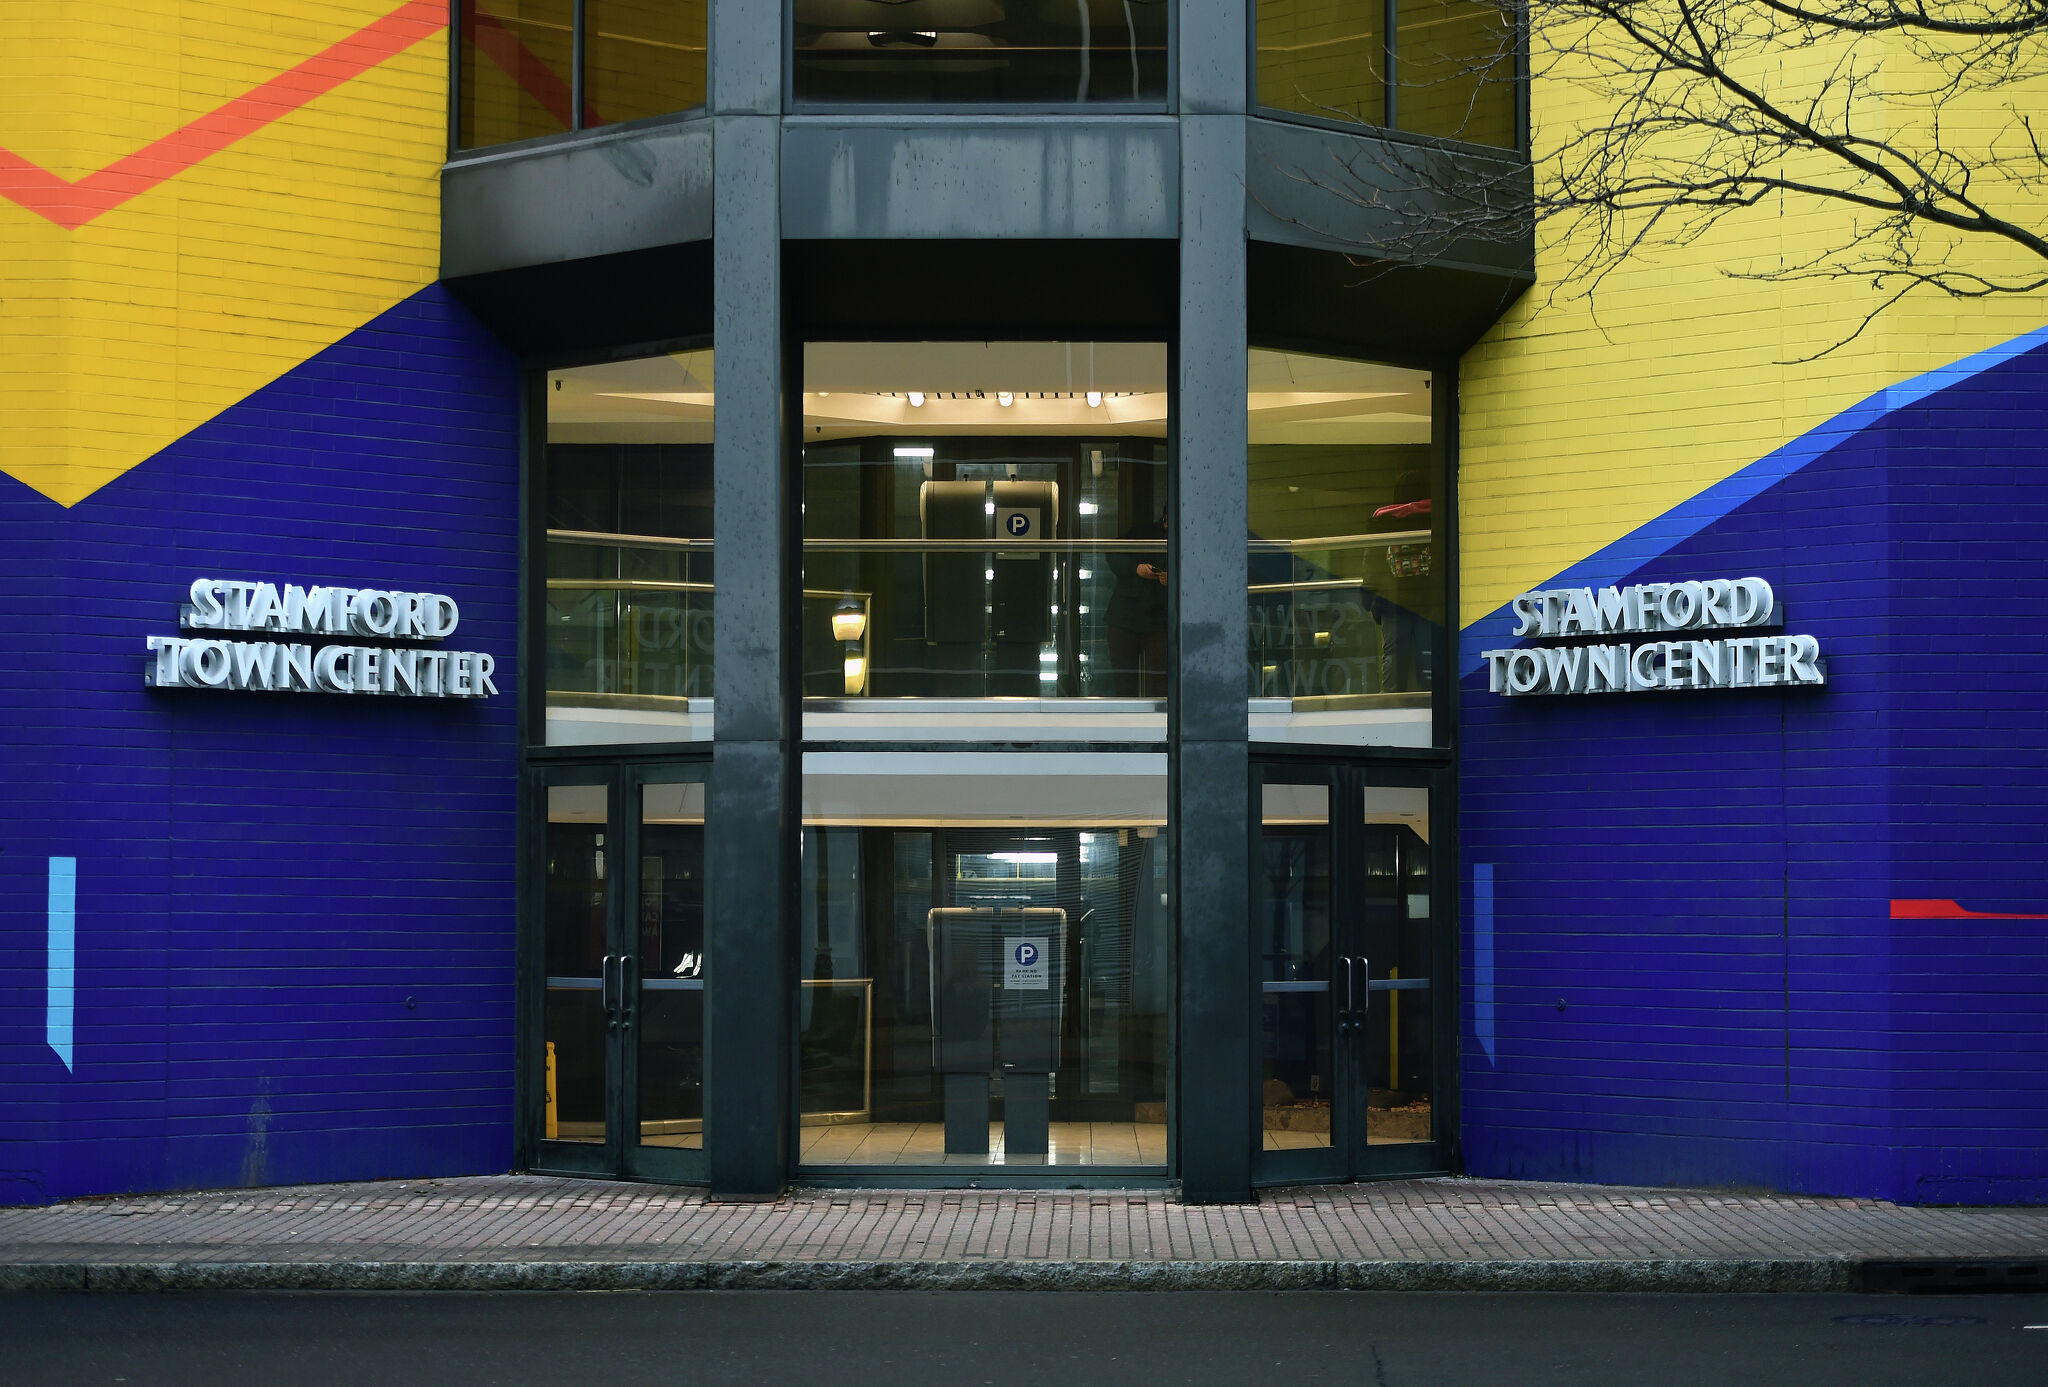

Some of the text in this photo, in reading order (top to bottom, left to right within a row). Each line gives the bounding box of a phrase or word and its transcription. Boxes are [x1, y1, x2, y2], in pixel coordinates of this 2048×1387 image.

[1012, 516, 1026, 533] P
[190, 578, 459, 637] STAMFORD
[1512, 577, 1774, 638] STAMFORD
[1021, 946, 1034, 963] P
